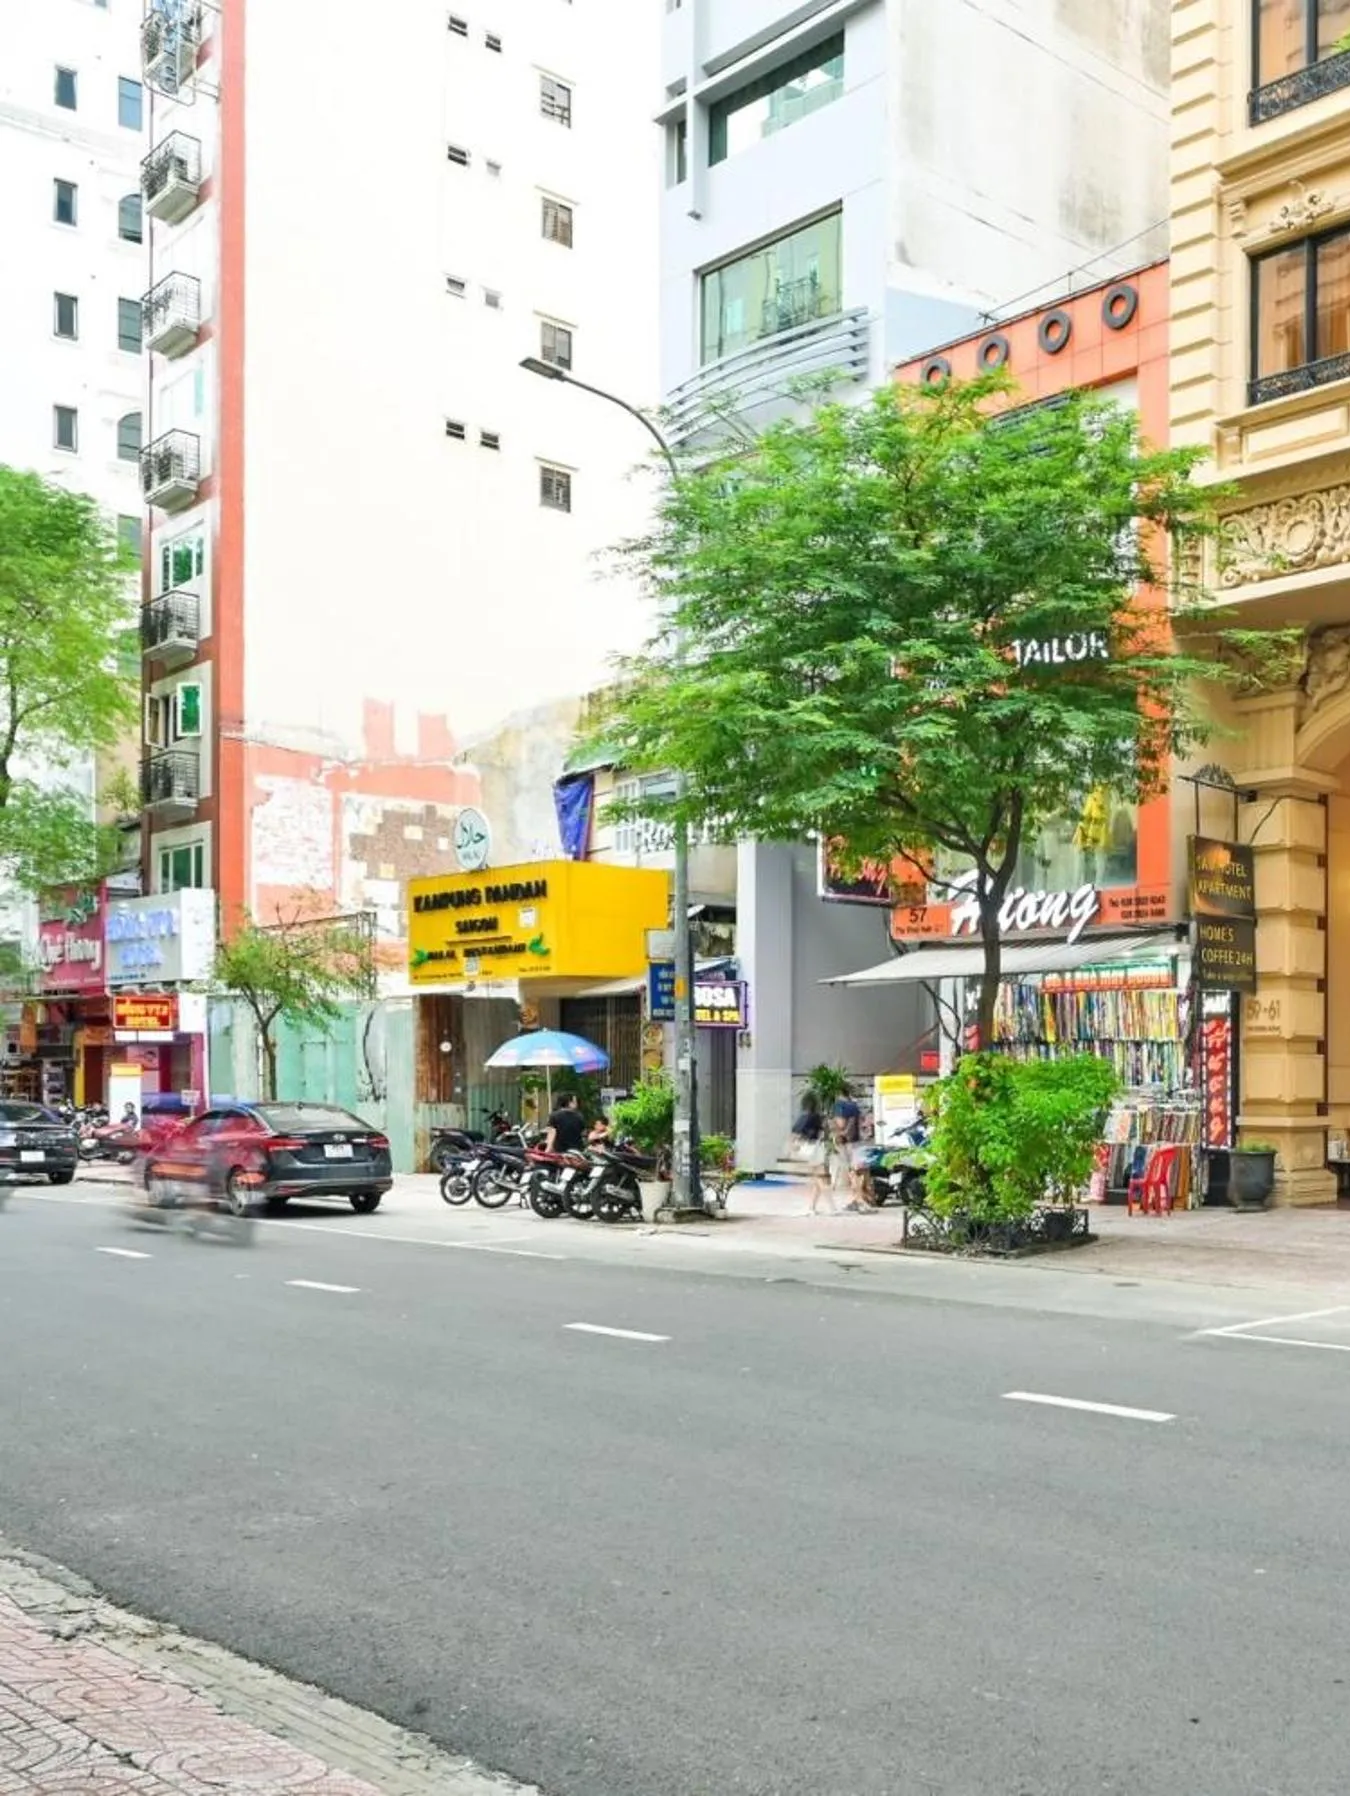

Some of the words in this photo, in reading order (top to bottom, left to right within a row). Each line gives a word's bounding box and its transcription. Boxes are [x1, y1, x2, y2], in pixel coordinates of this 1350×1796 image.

[413, 887, 483, 914] KAMPUNG
[1195, 879, 1253, 901] APARTMENT
[908, 907, 928, 923] 57
